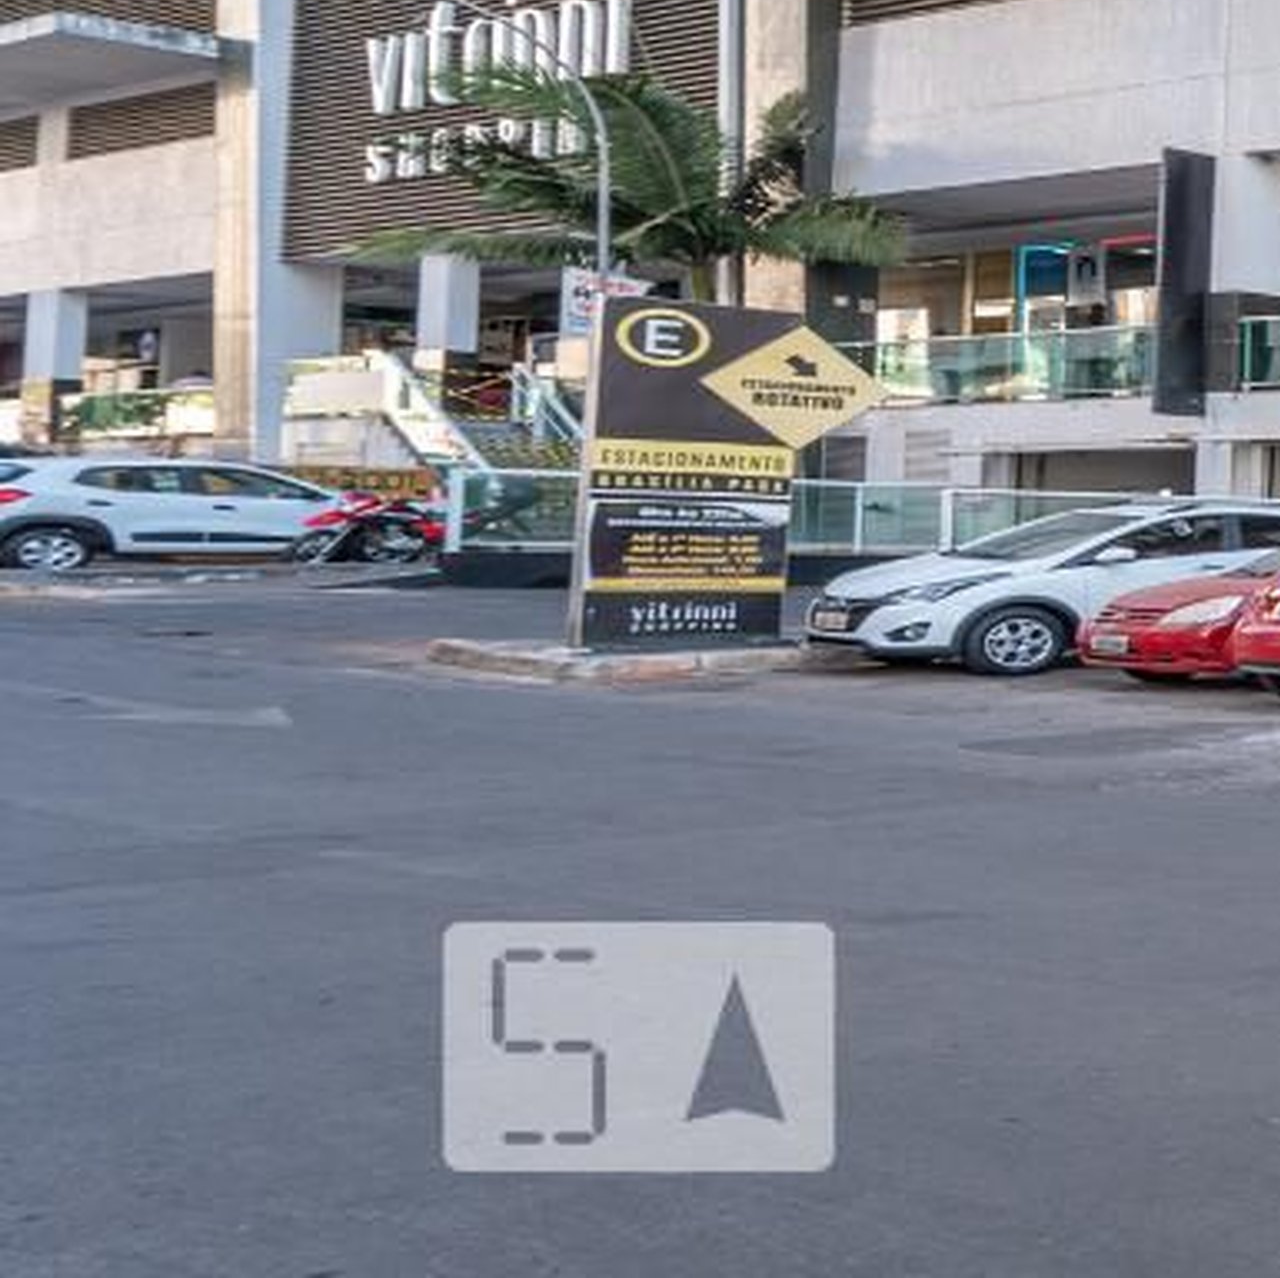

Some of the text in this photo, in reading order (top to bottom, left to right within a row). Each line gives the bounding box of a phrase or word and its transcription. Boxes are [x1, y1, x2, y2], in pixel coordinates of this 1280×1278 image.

[643, 318, 685, 357] E
[751, 391, 845, 412] ROTATIVO
[599, 447, 787, 473] ESTACIONAMENTO
[629, 600, 738, 622] vitrinni
